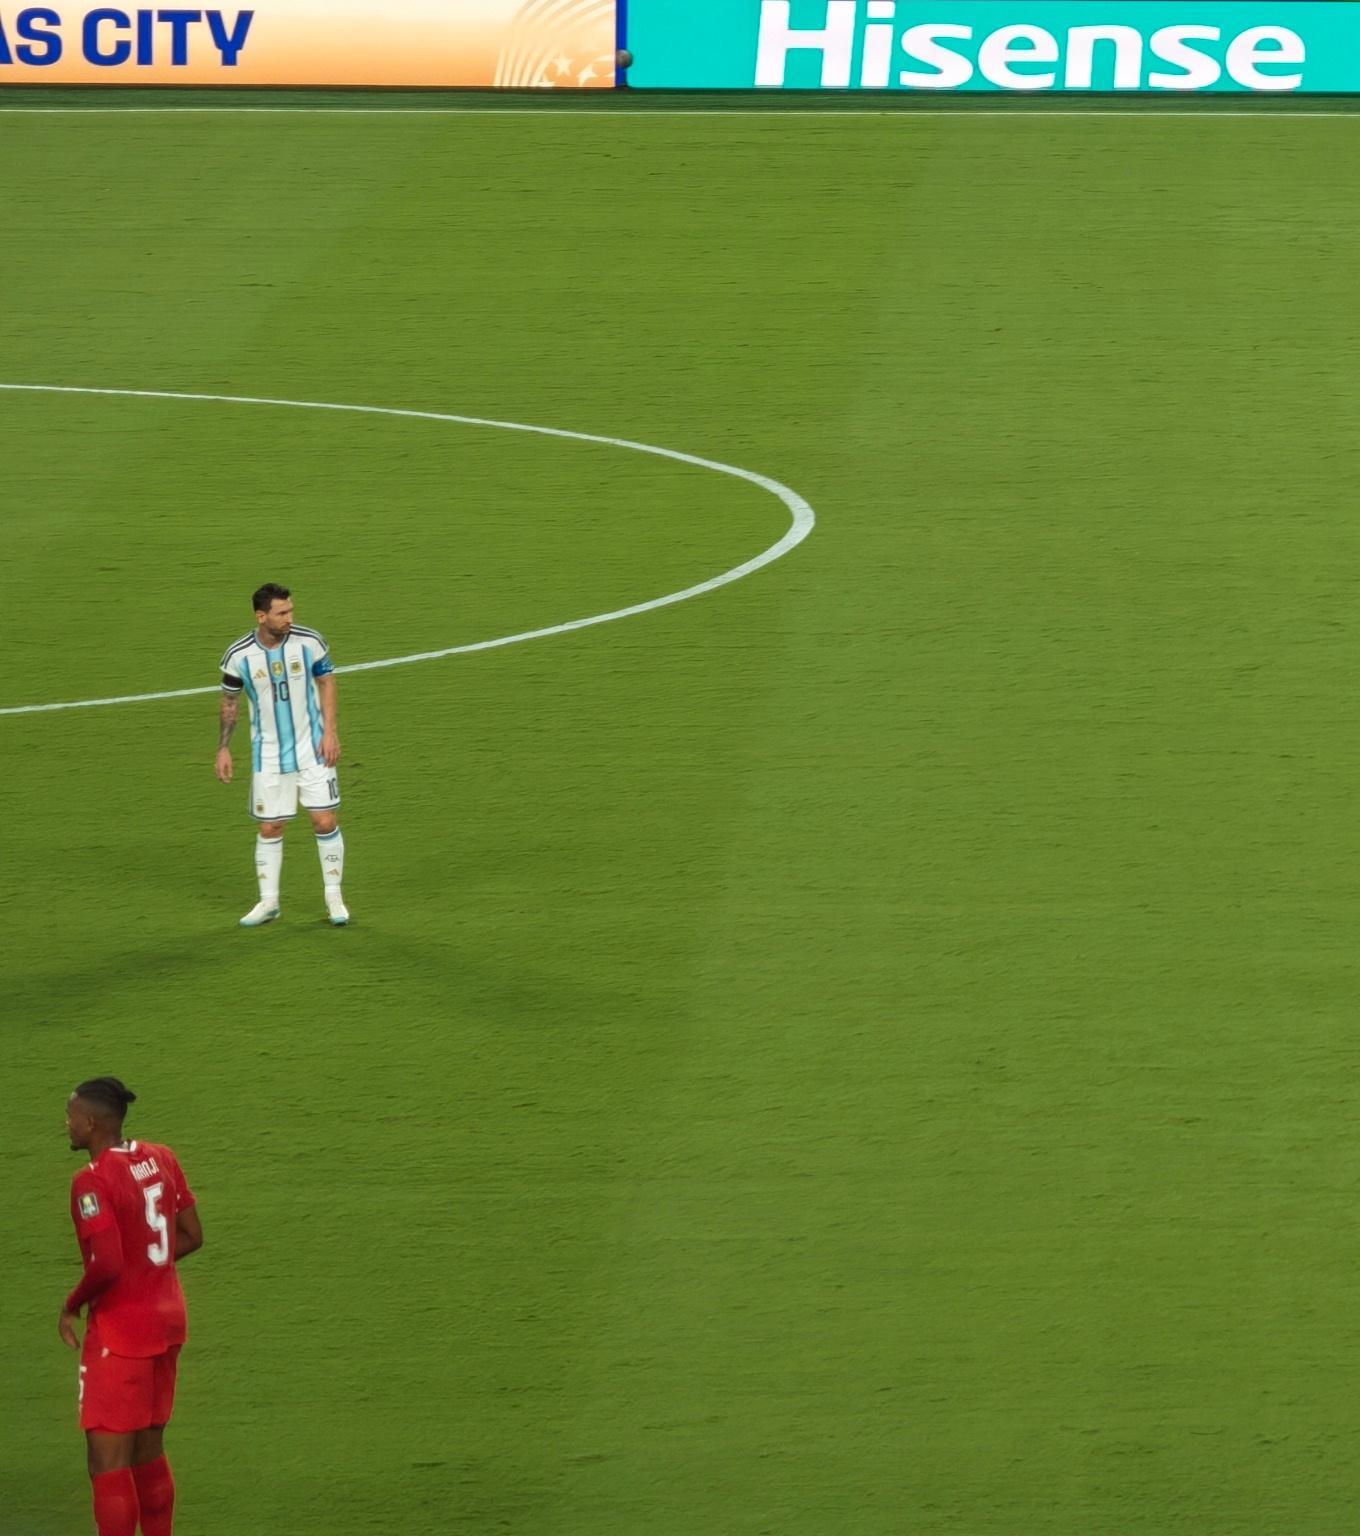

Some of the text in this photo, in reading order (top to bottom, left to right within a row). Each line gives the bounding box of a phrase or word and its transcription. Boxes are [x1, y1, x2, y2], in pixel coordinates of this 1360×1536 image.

[0, 7, 253, 66] S CITY
[754, 0, 1305, 91] Hisense
[271, 681, 290, 703] 10
[143, 1182, 169, 1266] 5
